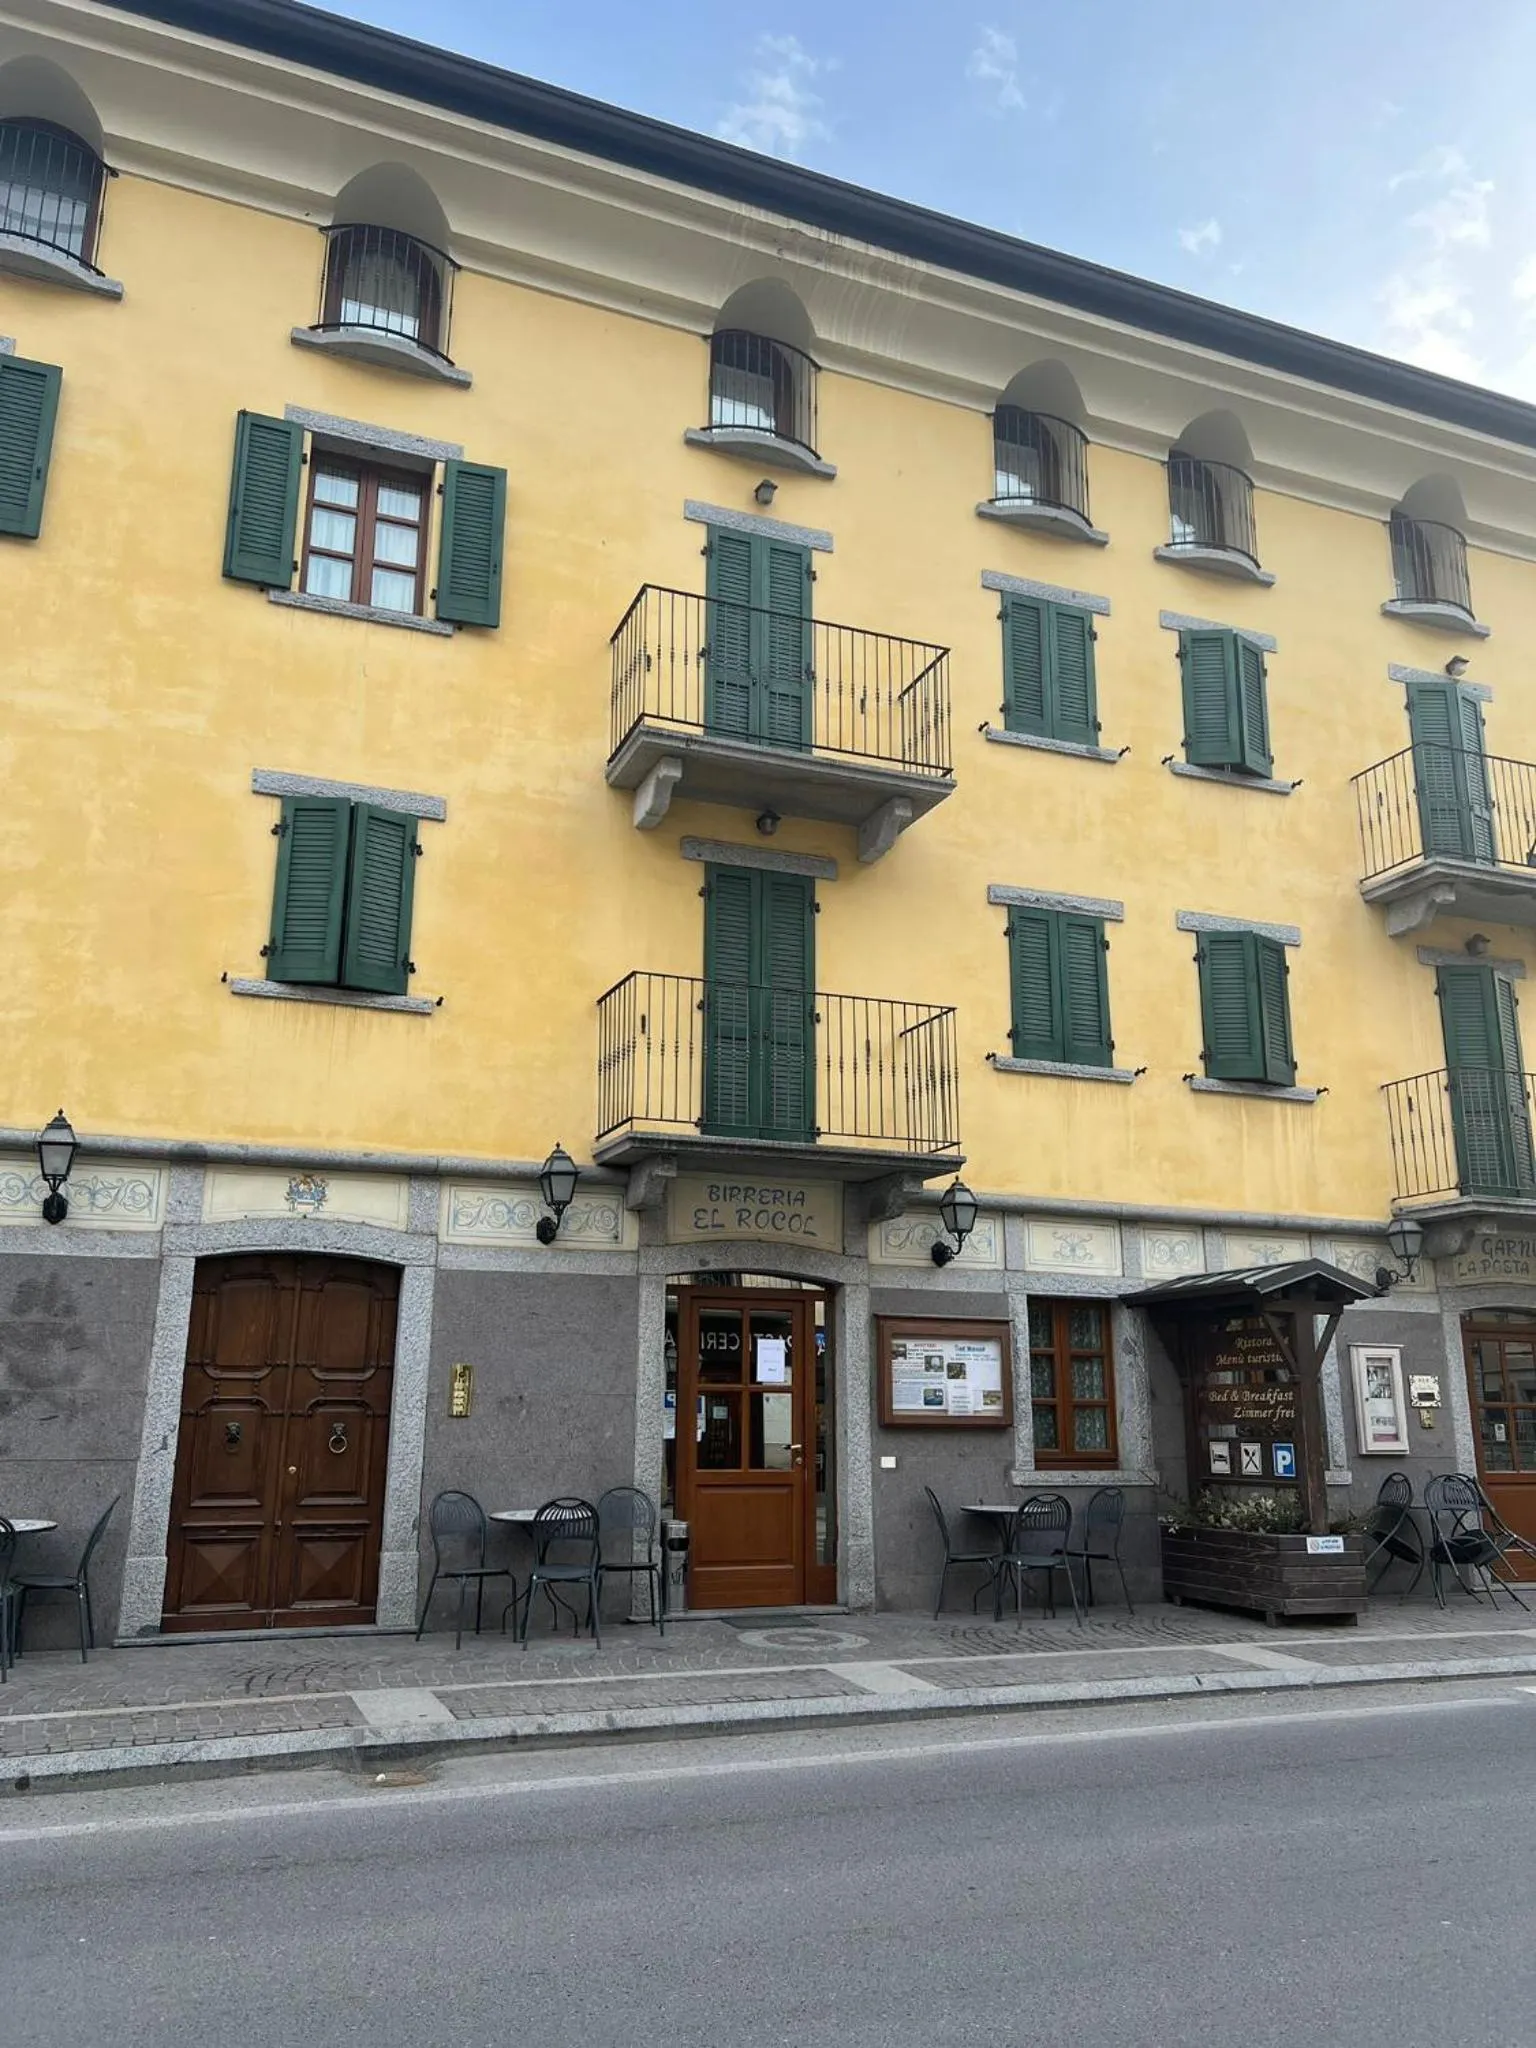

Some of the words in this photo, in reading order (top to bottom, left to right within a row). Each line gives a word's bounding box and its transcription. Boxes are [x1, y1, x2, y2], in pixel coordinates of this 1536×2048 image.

[707, 1184, 806, 1207] BIRRERIA
[693, 1208, 726, 1230] EL
[735, 1208, 818, 1237] ROCOL
[1458, 1261, 1477, 1277] LA
[1480, 1258, 1530, 1277] POSTA
[1208, 1389, 1229, 1402] Bed
[1230, 1389, 1239, 1402] &
[1241, 1388, 1294, 1405] Breakfast
[1233, 1406, 1273, 1419] Zimmer
[1273, 1404, 1296, 1422] frei
[1277, 1451, 1292, 1474] P
